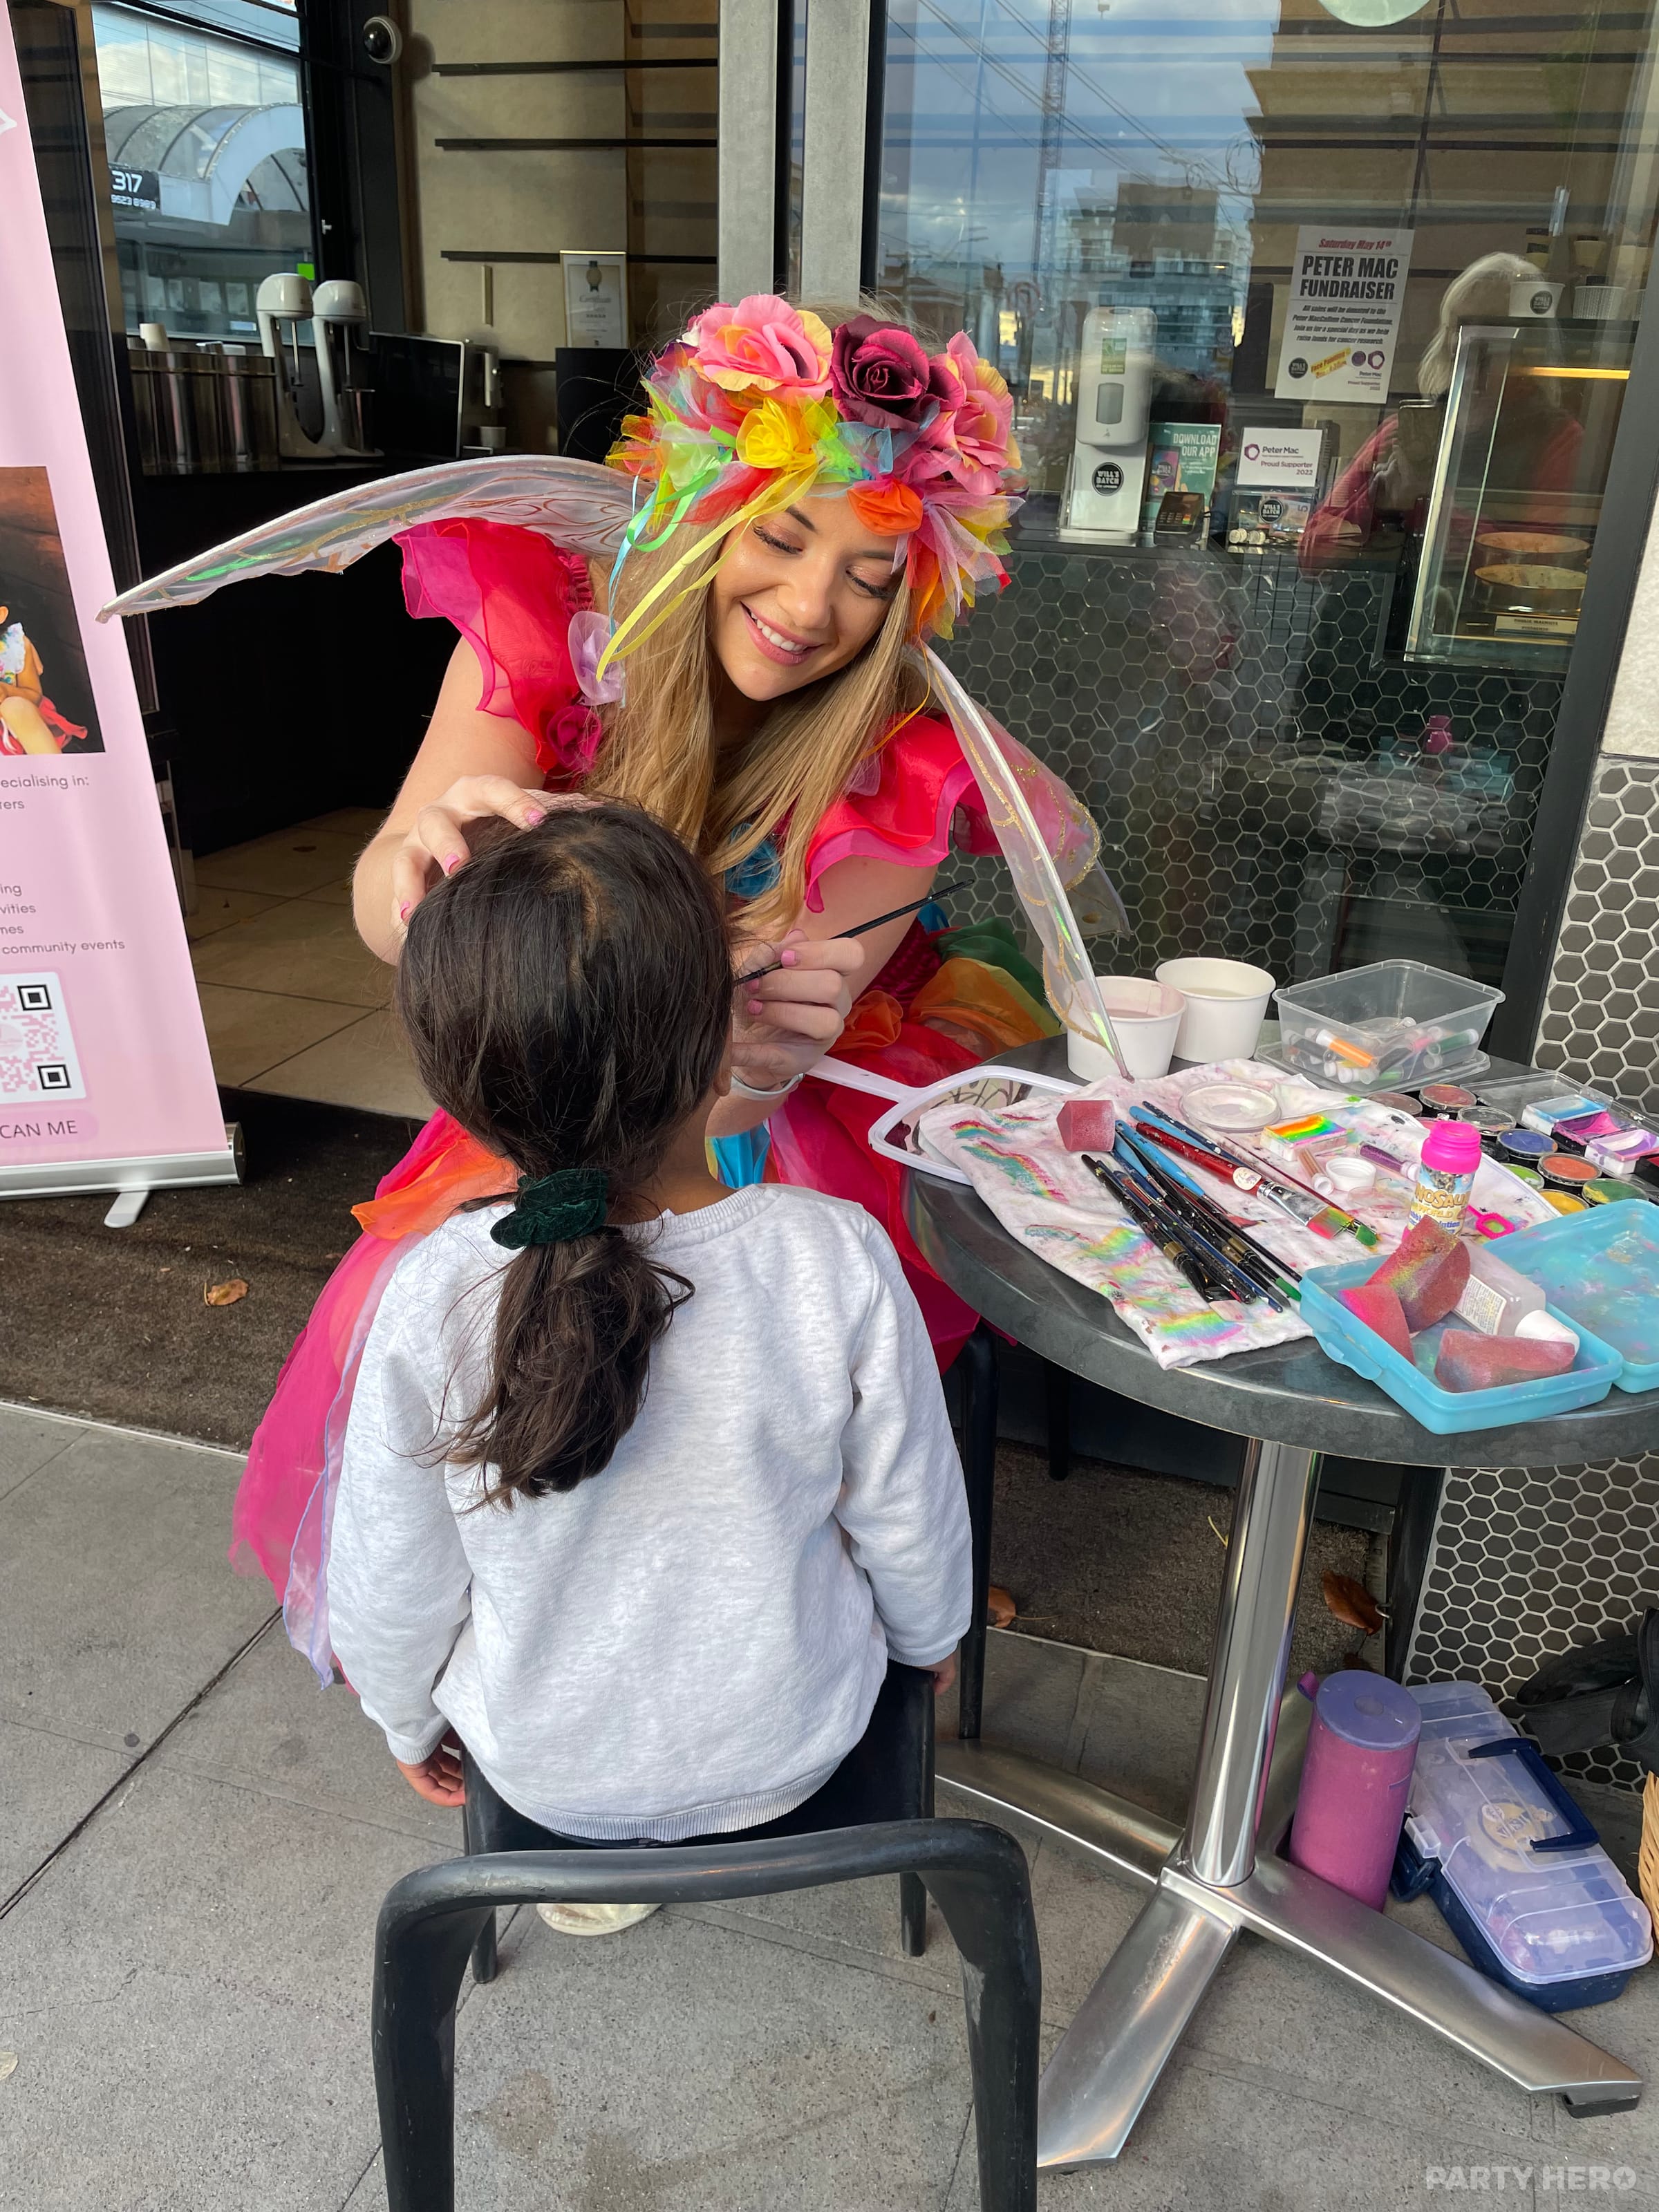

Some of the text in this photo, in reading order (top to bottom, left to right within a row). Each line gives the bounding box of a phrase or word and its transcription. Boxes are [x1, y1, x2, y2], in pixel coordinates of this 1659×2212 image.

[111, 170, 142, 193] 317
[1319, 238, 1356, 250] Saturday
[1356, 240, 1376, 250] May
[1302, 255, 1398, 279] PETER MAC
[1300, 279, 1395, 300] FUNDRAISER
[1173, 433, 1217, 446] DOWNLOAD
[1181, 446, 1215, 458] OUR APP
[1, 774, 89, 789] ecialising in:
[0, 903, 36, 914] vities
[2, 939, 125, 955] community events
[0, 1121, 77, 1138] CAN ME
